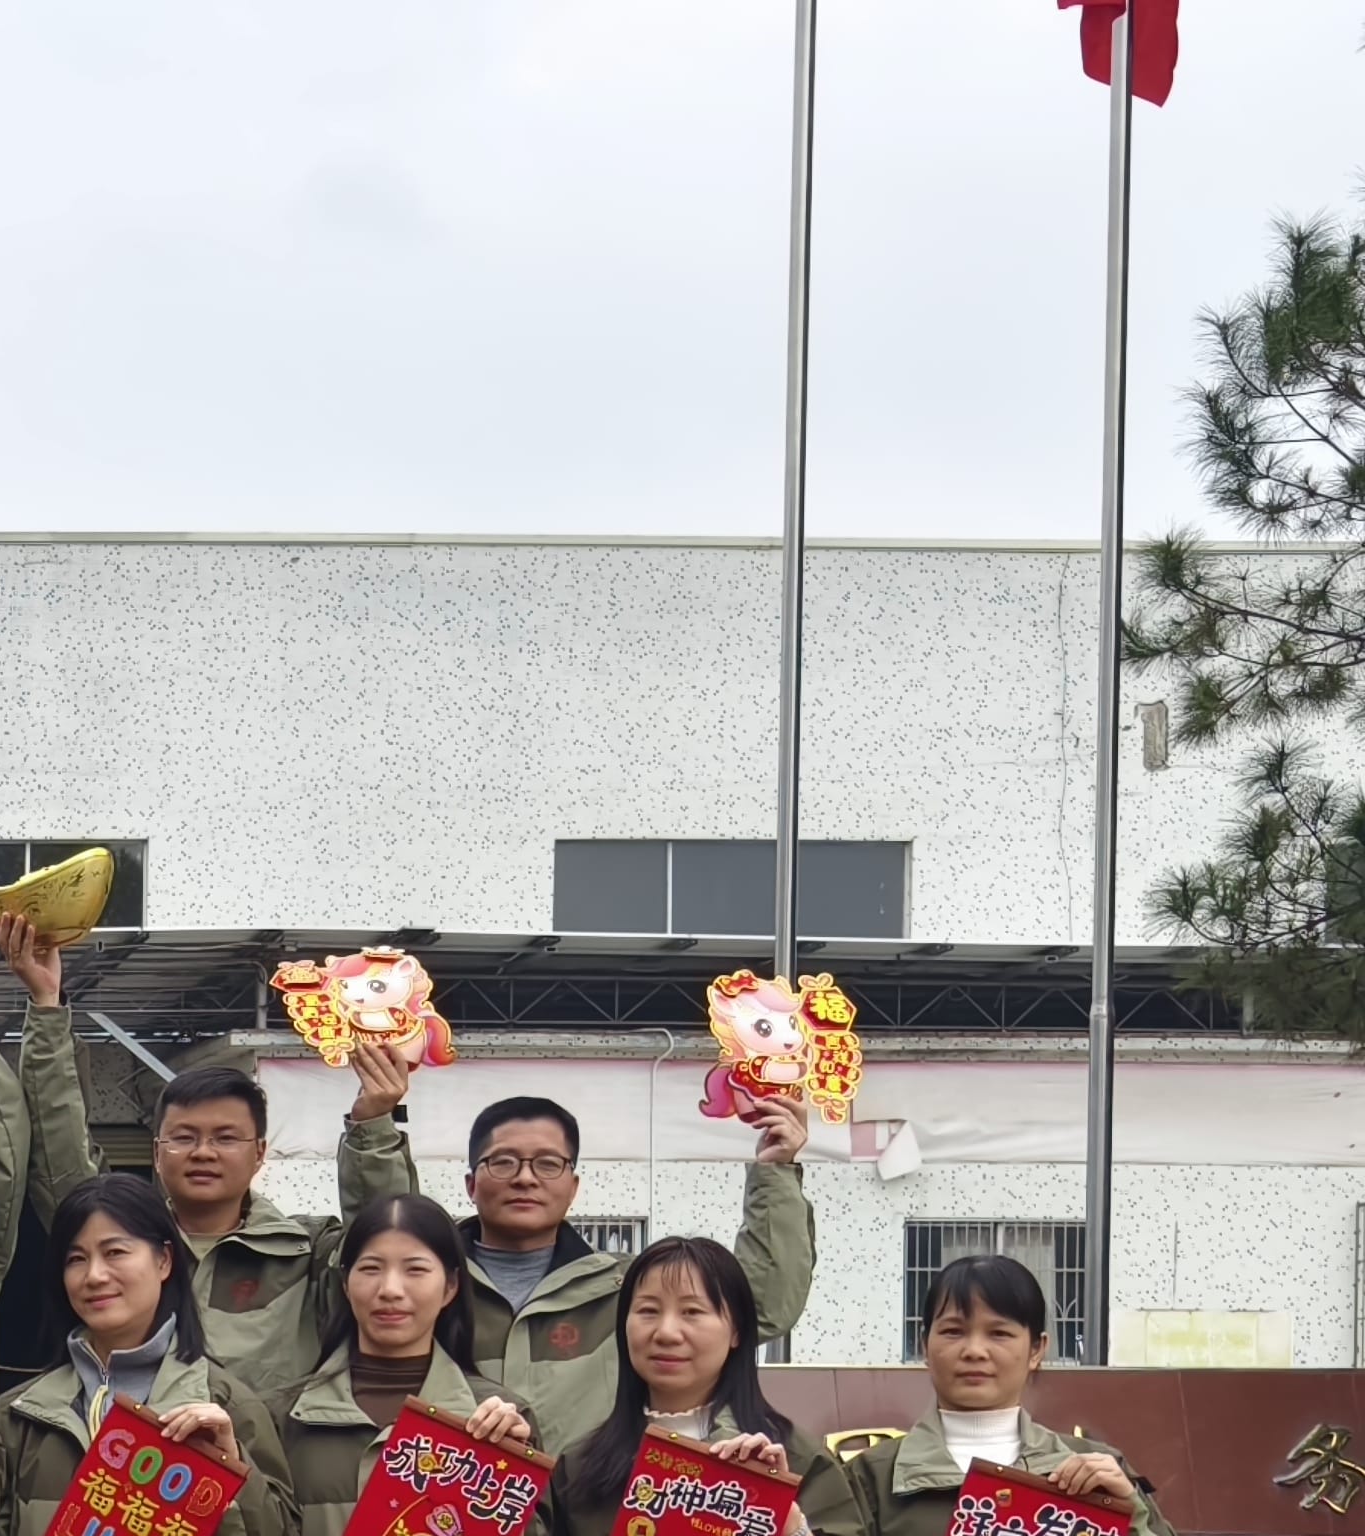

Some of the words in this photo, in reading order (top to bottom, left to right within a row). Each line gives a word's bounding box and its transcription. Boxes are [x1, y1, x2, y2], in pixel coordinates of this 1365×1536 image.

[809, 990, 851, 1024] 福
[98, 1429, 223, 1517] GOOD
[384, 1434, 537, 1535] 成功上岸
